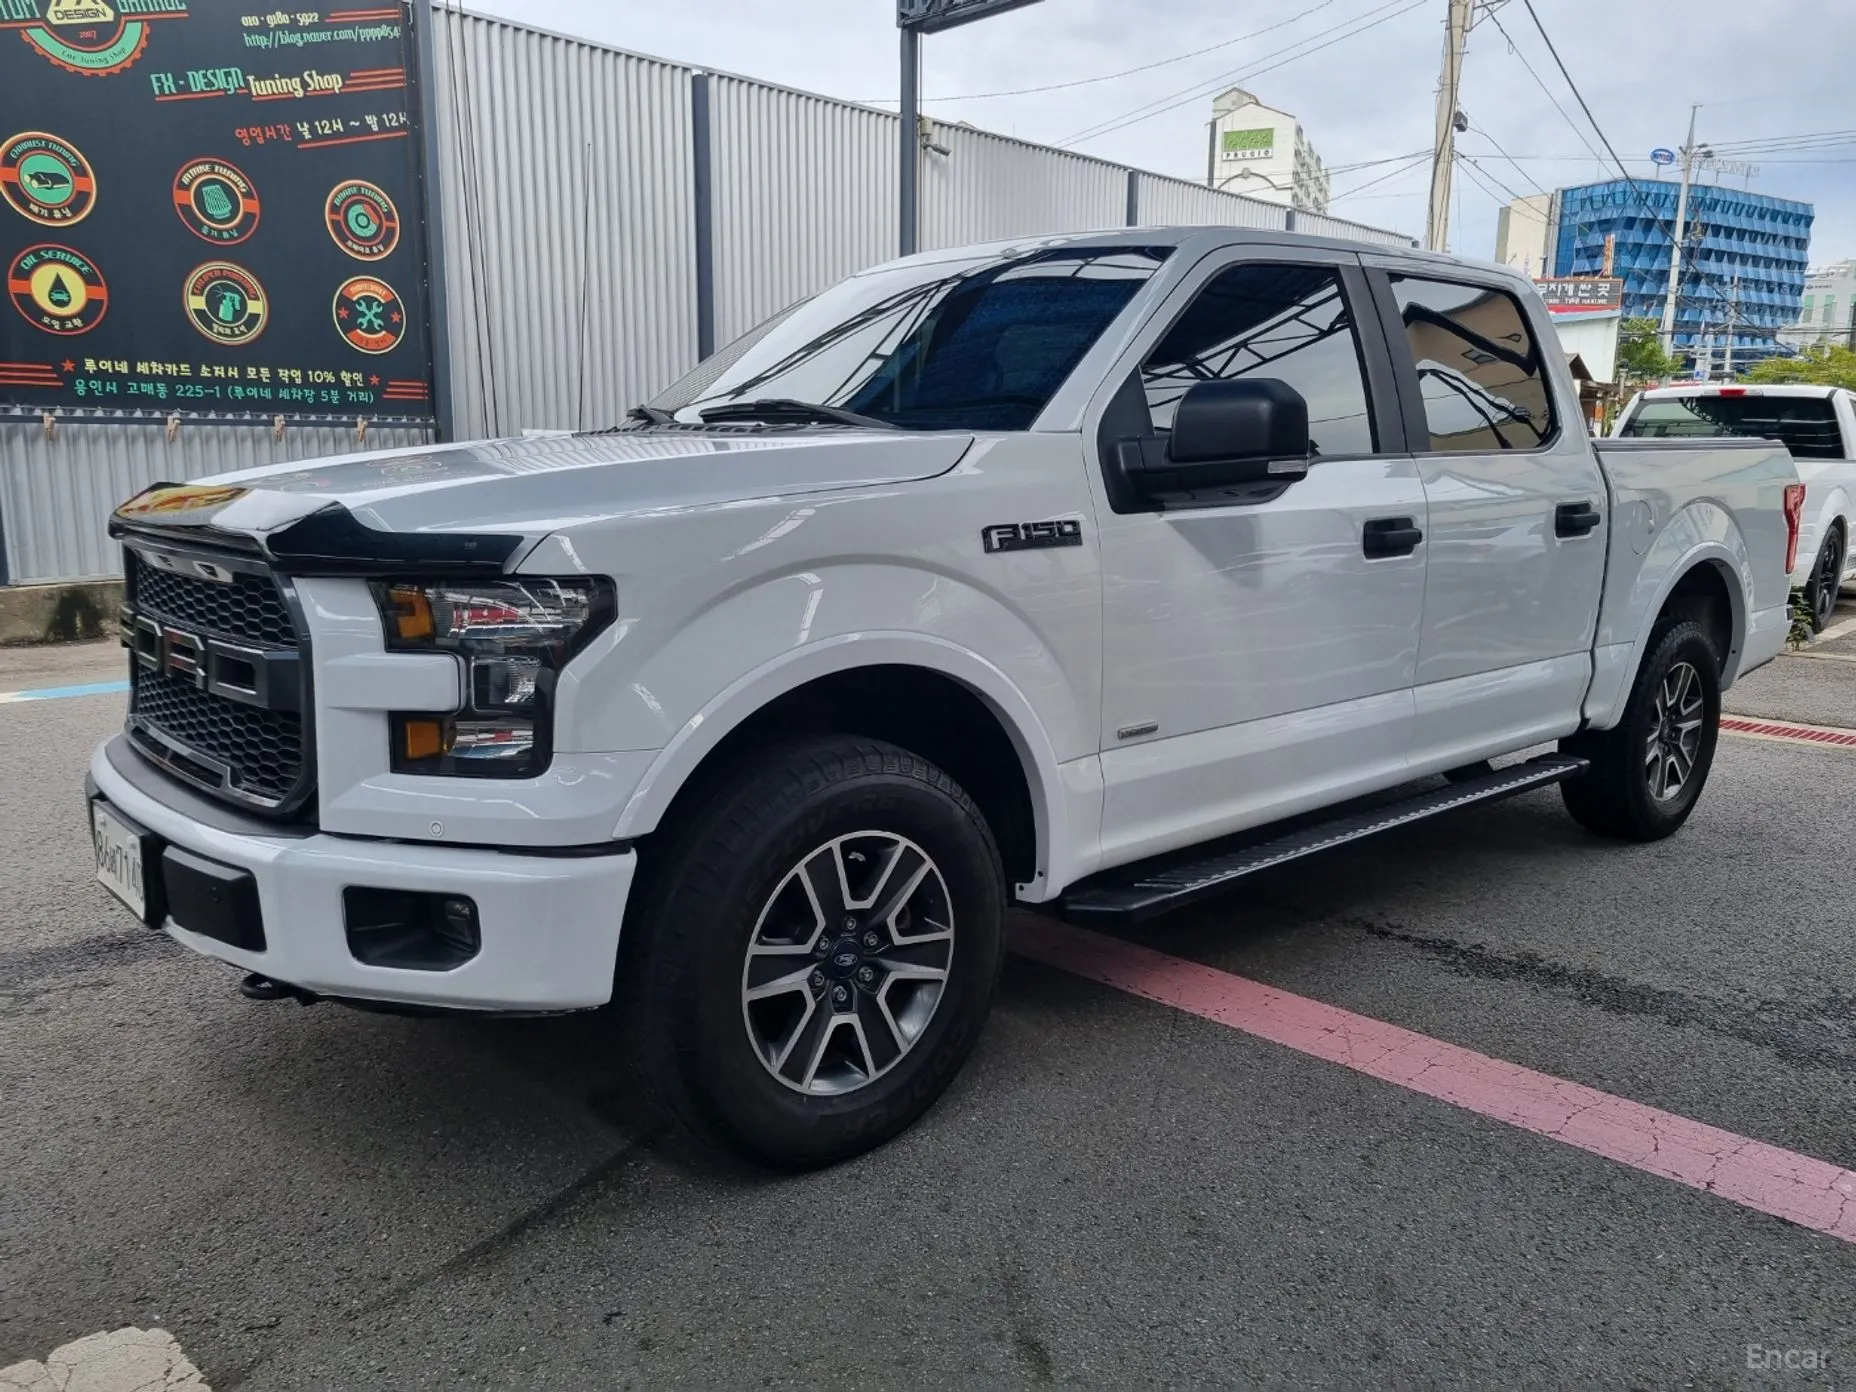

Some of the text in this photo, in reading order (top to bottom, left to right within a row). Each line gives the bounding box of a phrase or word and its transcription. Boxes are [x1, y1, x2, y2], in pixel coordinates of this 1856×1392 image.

[54, 8, 107, 20] DESIGN
[246, 74, 304, 98] Tuning
[304, 70, 343, 94] Shop
[234, 123, 292, 146] 영업시간
[296, 121, 312, 140] 낮
[314, 118, 344, 135] 12시
[365, 114, 379, 132] 밤
[20, 249, 94, 275] OIL SERVICE
[84, 358, 364, 387] 루이네 세차카드 소지시 모든 작업 10% 할인
[74, 378, 374, 405] 용인시 고매동 225-1 (루이네 세차장 5분 거리)
